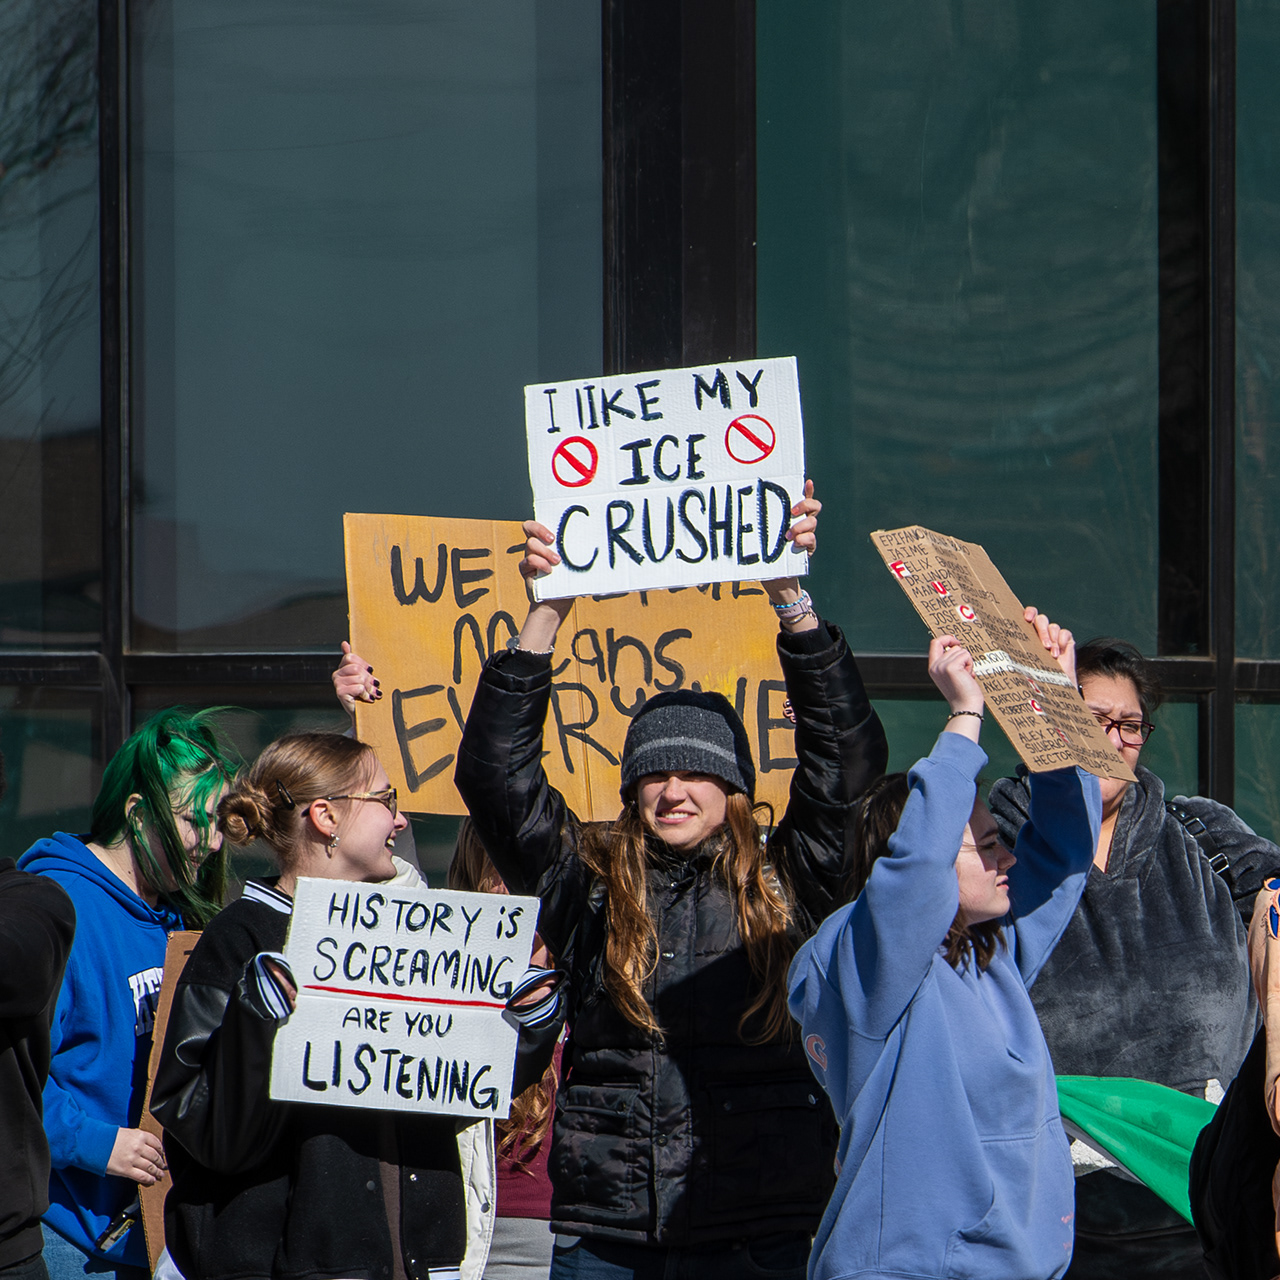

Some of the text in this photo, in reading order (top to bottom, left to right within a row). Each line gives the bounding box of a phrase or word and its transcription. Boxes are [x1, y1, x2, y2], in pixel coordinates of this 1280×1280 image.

[543, 387, 561, 433] I
[692, 368, 764, 411] MY
[618, 433, 707, 485] ICE
[555, 477, 792, 573] CRUSHED
[390, 543, 494, 608] WE
[921, 595, 958, 613] RENEE
[930, 608, 960, 626] JOSE
[956, 631, 984, 646] EITH
[1018, 729, 1046, 743] ALEX
[328, 892, 482, 947] HISTORY
[313, 937, 514, 999] SCREAMING
[342, 1007, 453, 1037] ARE YOU
[302, 1040, 499, 1112] LISTENING
